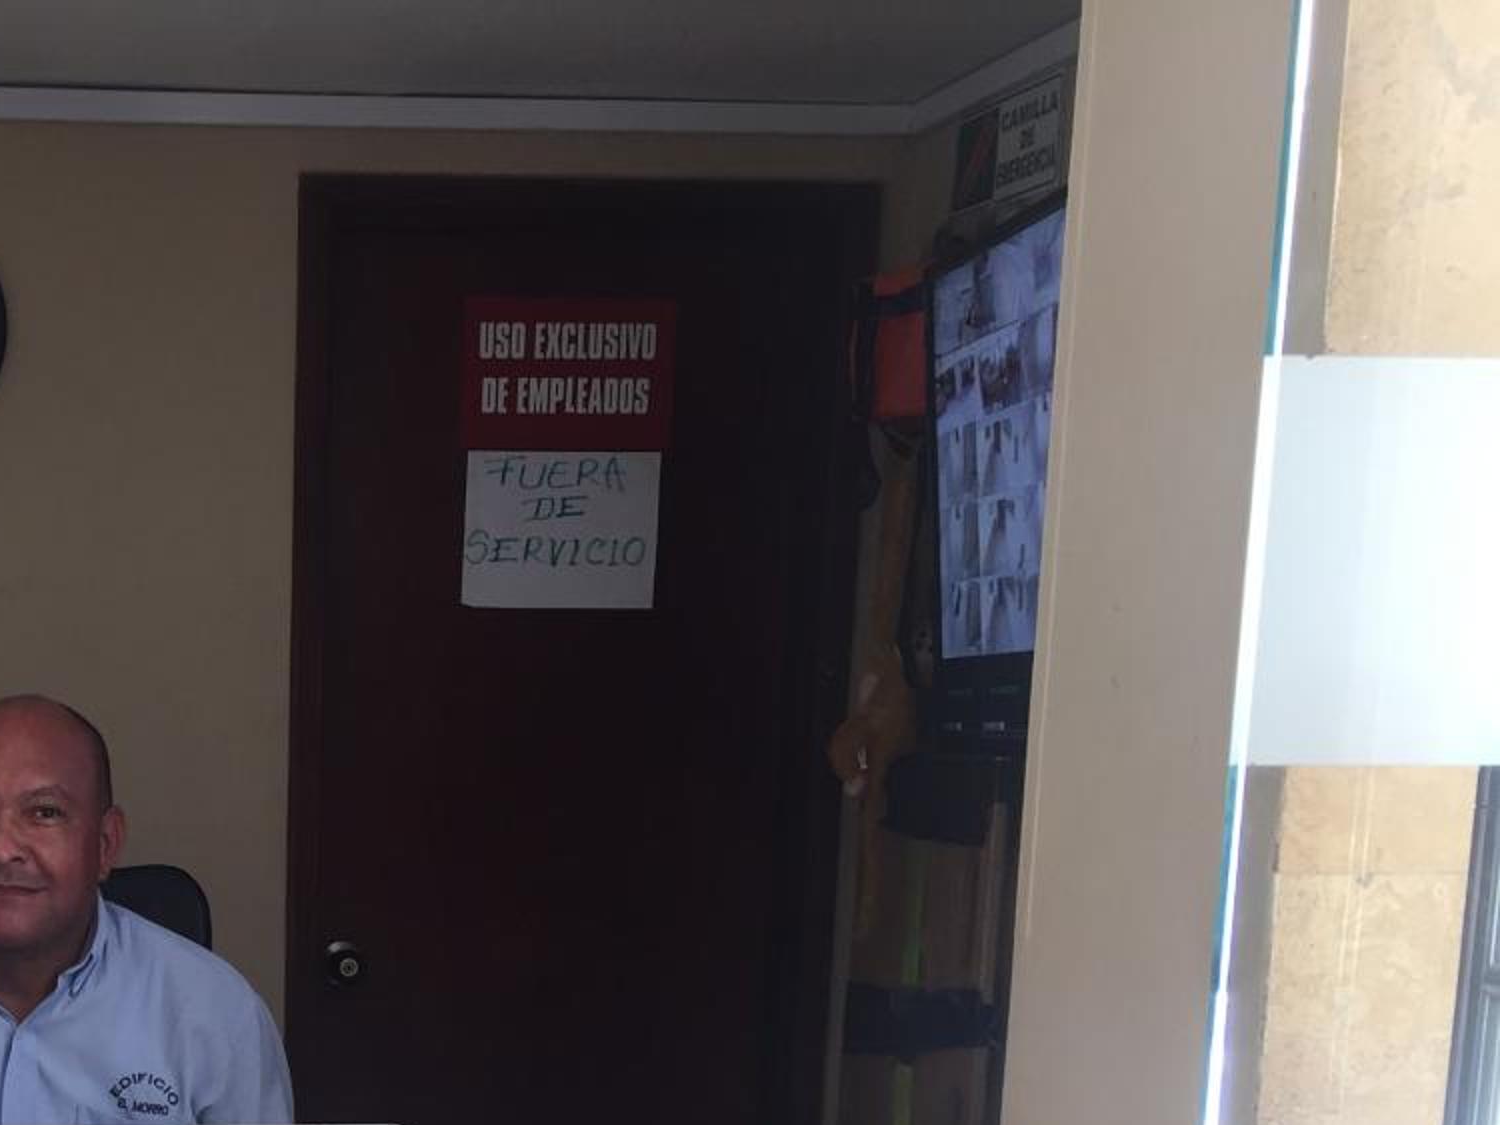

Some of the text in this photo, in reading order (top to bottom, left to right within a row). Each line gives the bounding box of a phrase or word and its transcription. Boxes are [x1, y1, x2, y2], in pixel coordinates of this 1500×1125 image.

[479, 321, 658, 361] USO EXCLUSIVO
[480, 376, 651, 415] DE EMPLEADOS
[484, 455, 628, 492] FUERA
[520, 494, 589, 523] DE
[465, 528, 646, 568] SERVICIO
[109, 1072, 179, 1106] EDIFICIO
